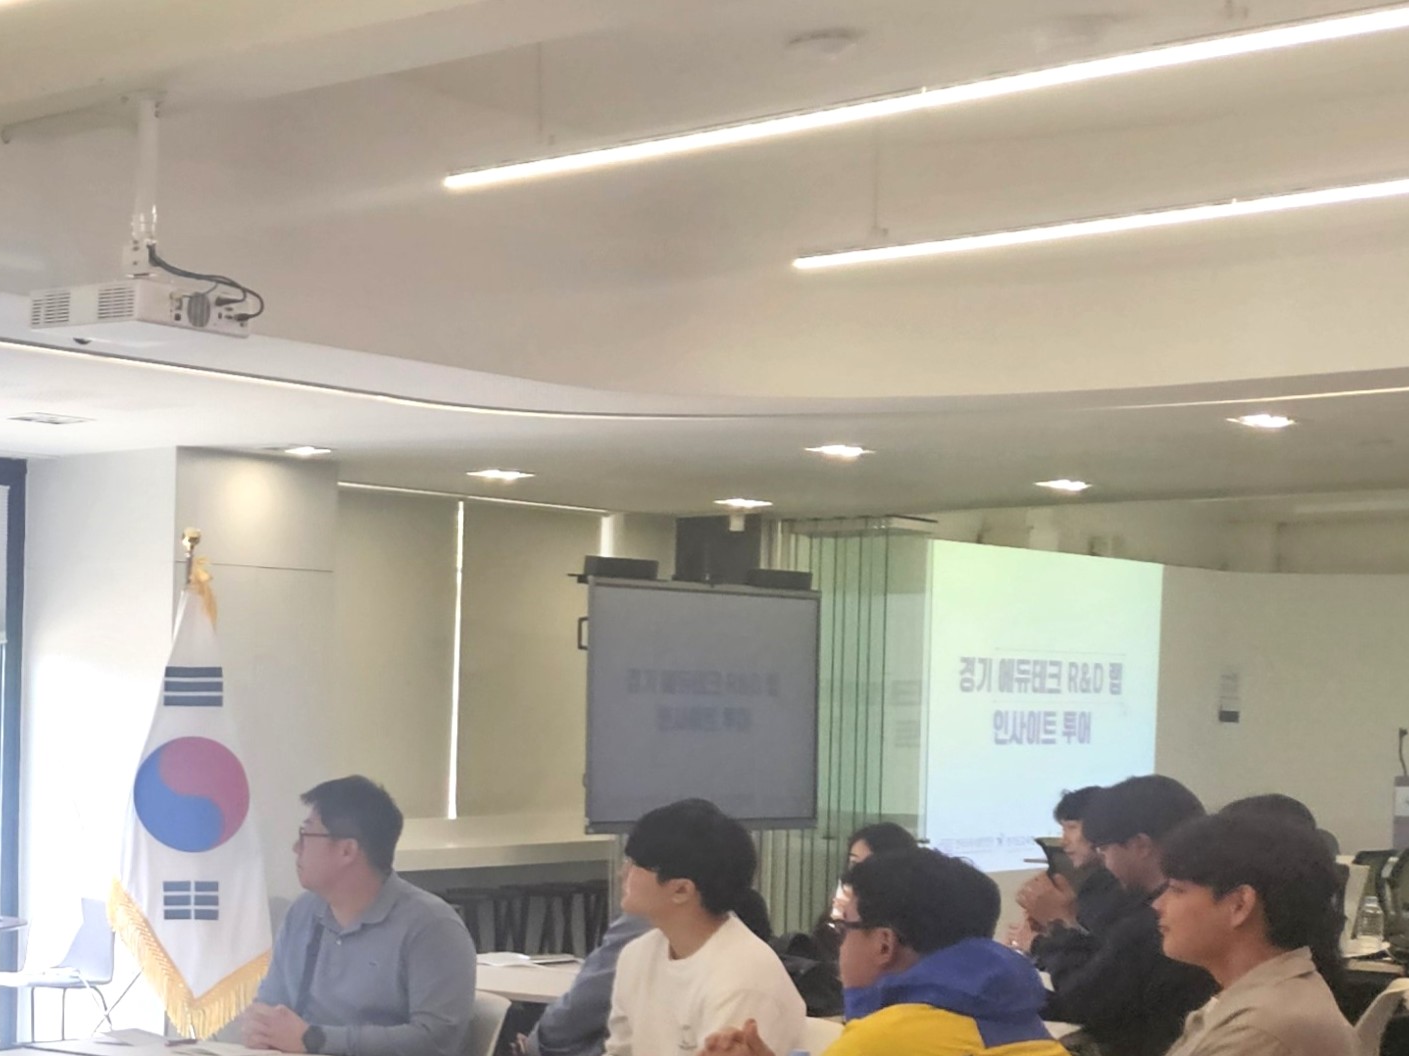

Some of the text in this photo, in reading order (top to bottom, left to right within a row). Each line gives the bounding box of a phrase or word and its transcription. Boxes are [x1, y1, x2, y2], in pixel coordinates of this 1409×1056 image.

[959, 656, 994, 693] 경기
[997, 657, 1063, 695] 에듀테크
[1067, 661, 1104, 694] R&D
[992, 709, 1092, 745] 인사이트 투어
